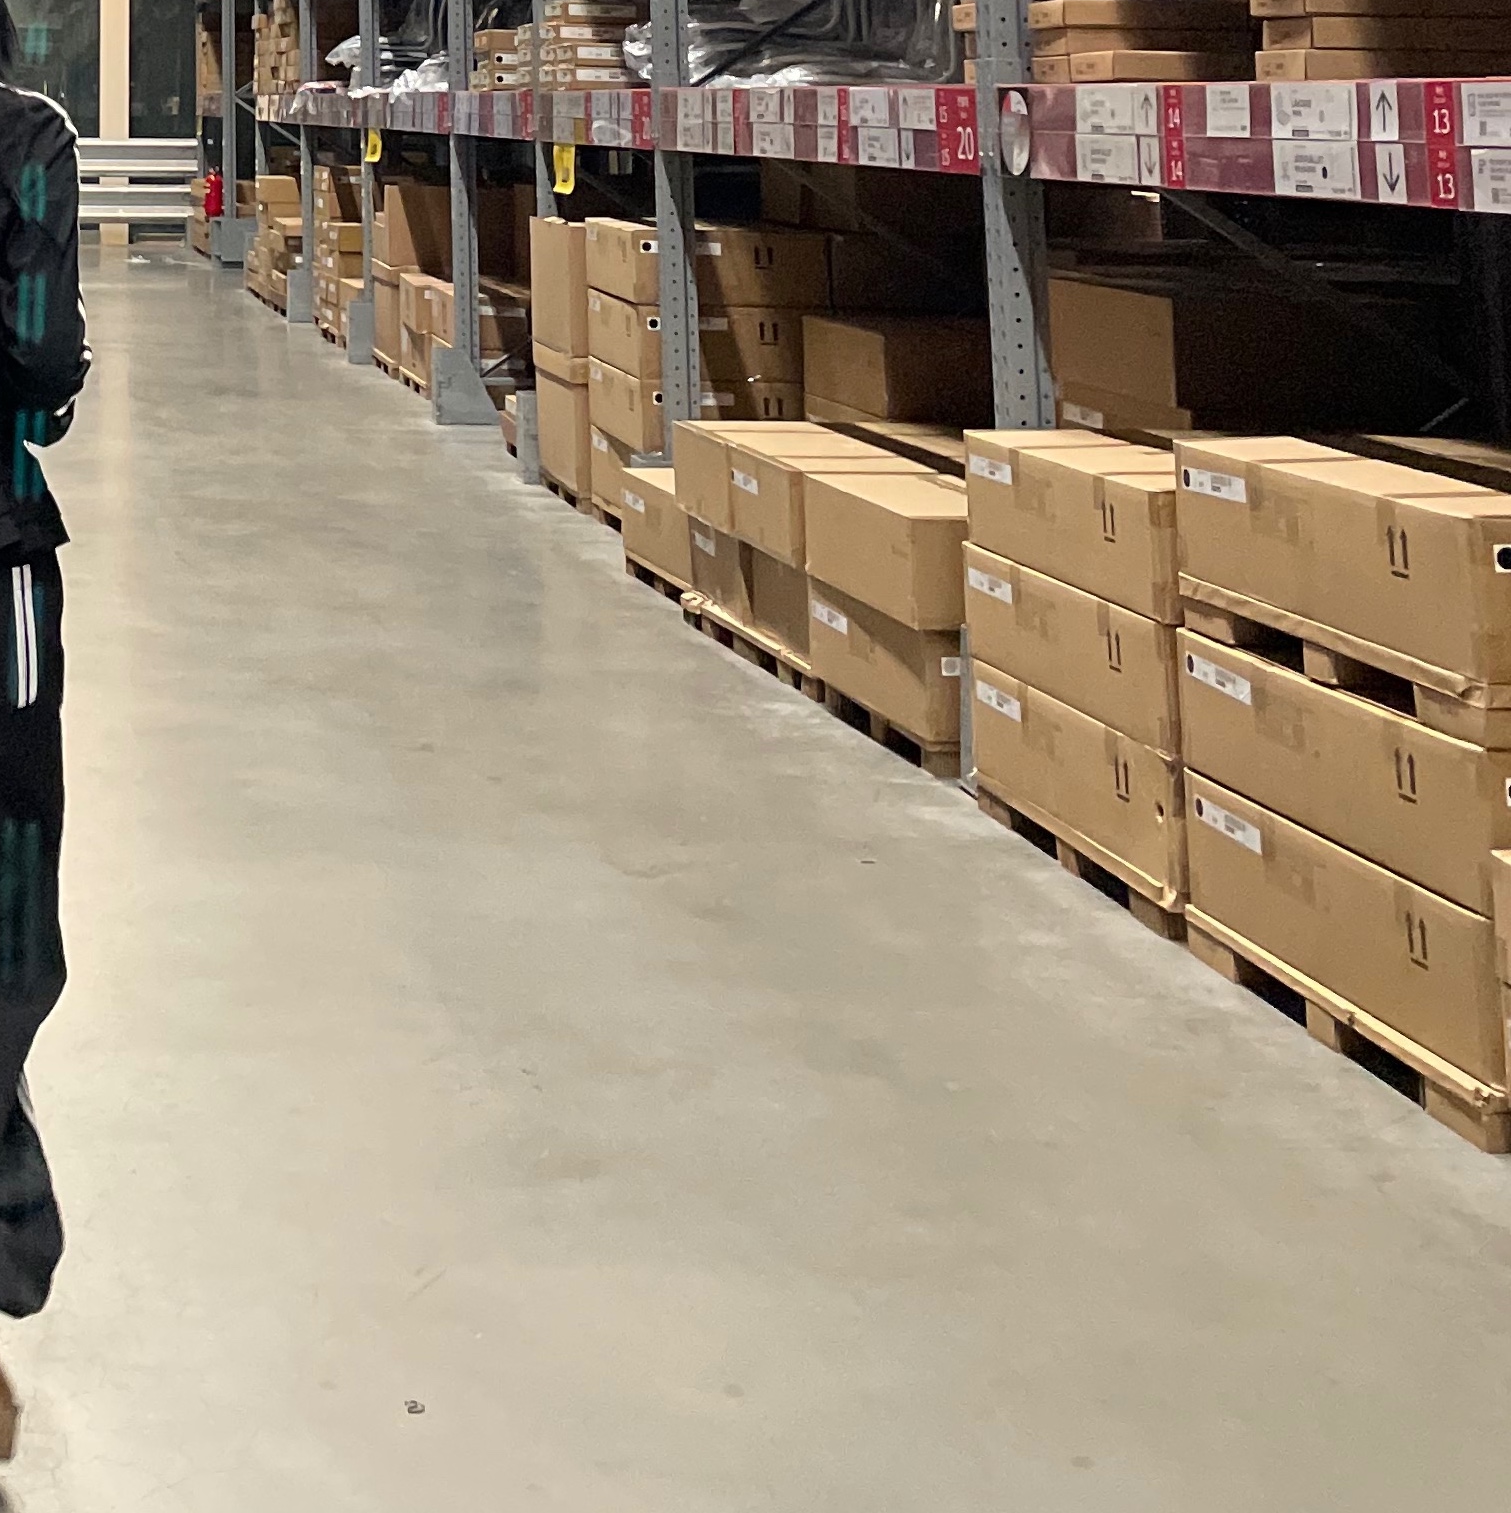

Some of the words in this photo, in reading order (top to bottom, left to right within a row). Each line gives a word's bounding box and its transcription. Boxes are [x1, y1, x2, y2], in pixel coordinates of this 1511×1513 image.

[1167, 108, 1180, 128] 14
[1433, 109, 1451, 134] 13
[956, 126, 975, 161] 20
[1170, 160, 1182, 182] 14
[1438, 173, 1455, 199] 13
